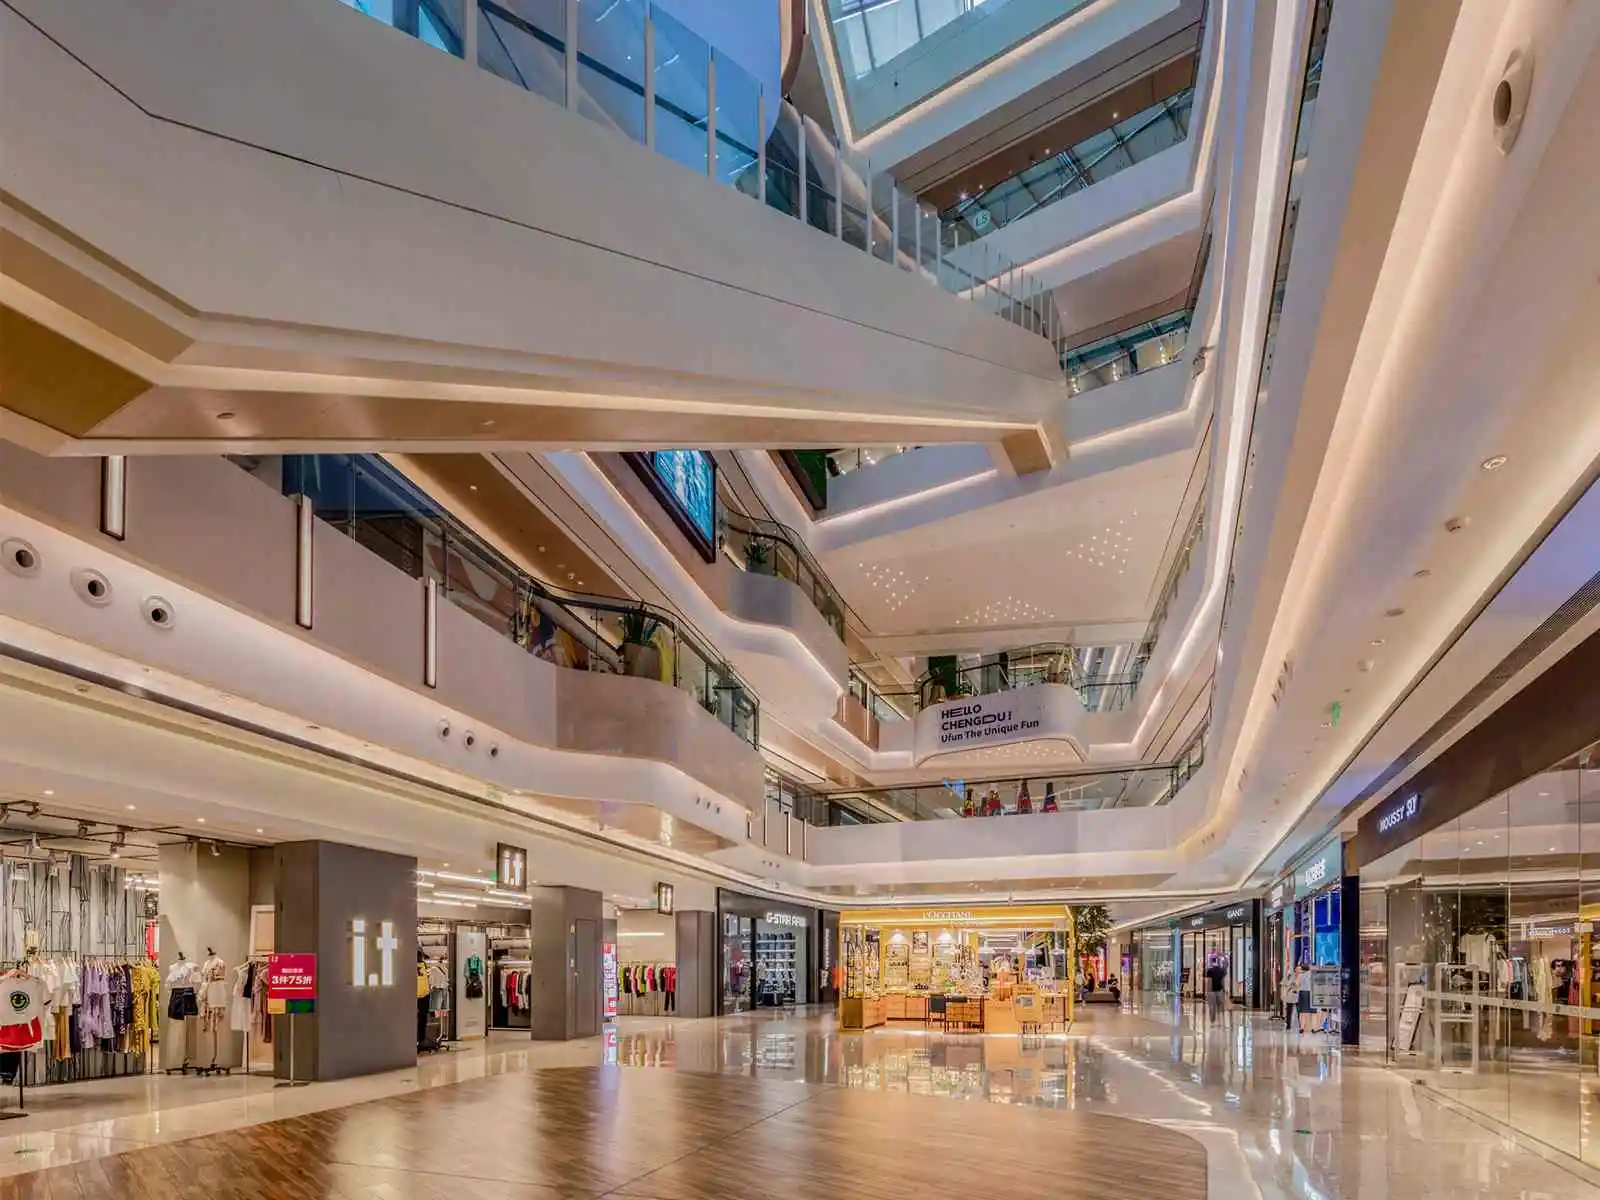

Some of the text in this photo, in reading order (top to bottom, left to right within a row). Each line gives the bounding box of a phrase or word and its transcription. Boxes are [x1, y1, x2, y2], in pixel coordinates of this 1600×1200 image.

[941, 704, 982, 719] HELLO
[941, 719, 1039, 743] Ufun The Unique Fun
[1227, 908, 1244, 919] GANT
[353, 919, 398, 986] i.t
